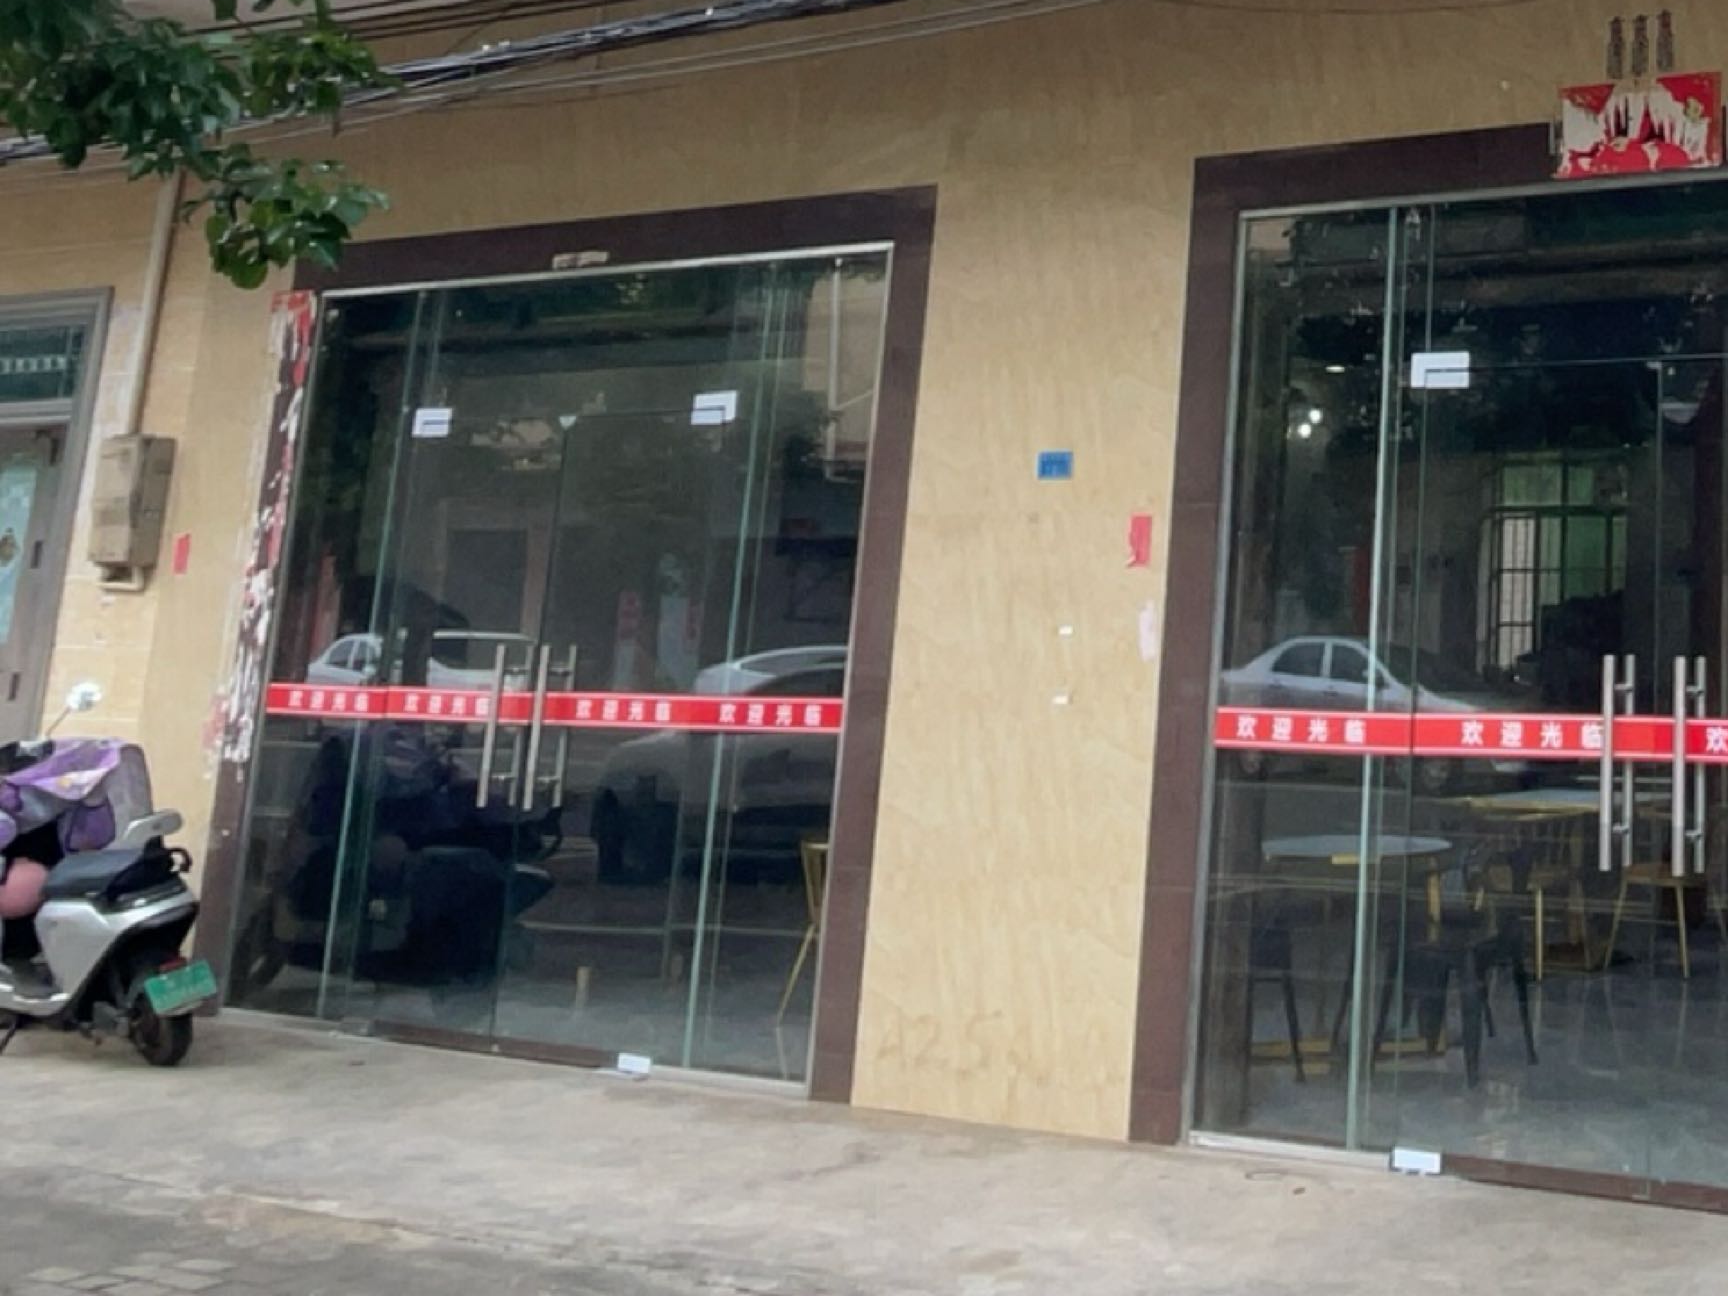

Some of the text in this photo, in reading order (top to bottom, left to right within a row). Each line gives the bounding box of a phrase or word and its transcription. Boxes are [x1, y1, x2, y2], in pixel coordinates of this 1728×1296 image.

[576, 699, 671, 722] 欢迎光临
[719, 703, 822, 727] 欢迎光临
[1236, 715, 1367, 744] 欢迎光临
[1460, 719, 1603, 749] 欢迎光临
